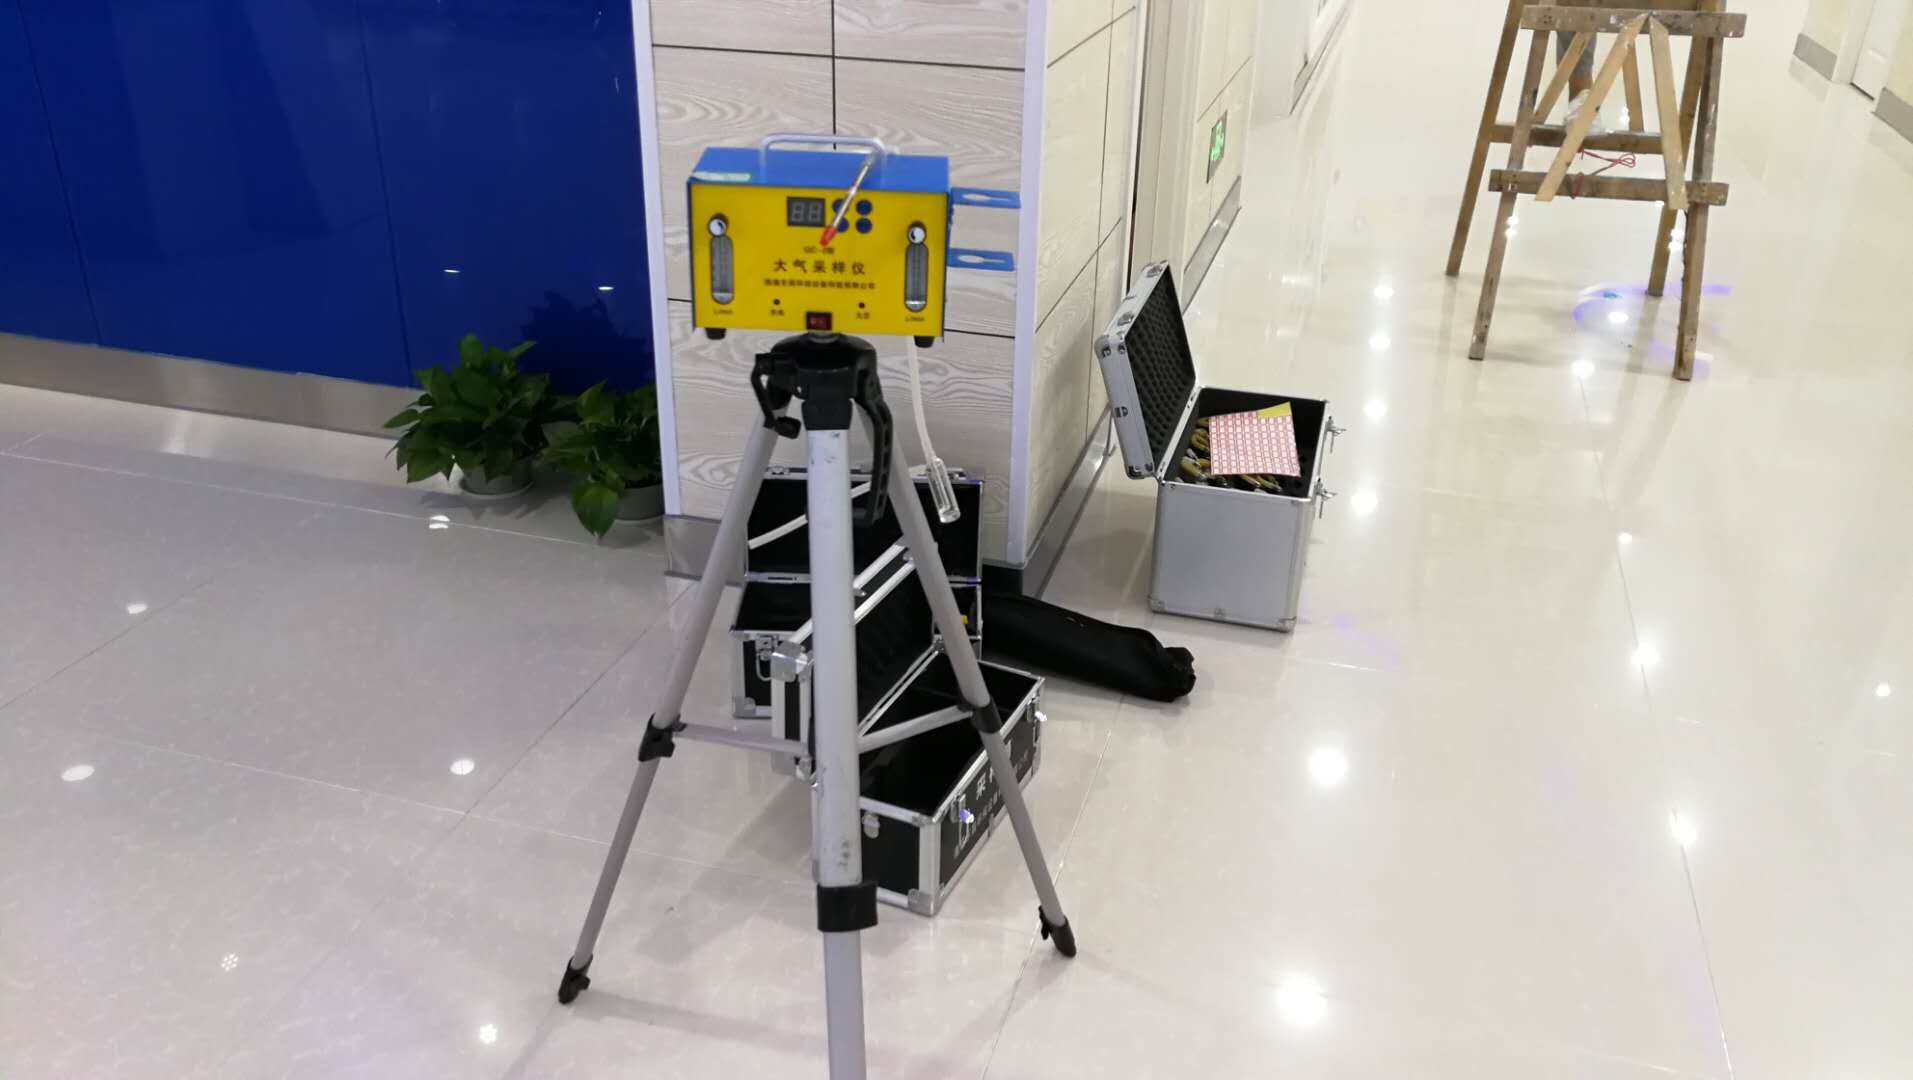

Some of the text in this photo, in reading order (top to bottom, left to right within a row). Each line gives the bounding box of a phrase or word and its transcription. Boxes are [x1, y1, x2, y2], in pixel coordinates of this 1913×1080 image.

[773, 258, 866, 275] 大气采样仪
